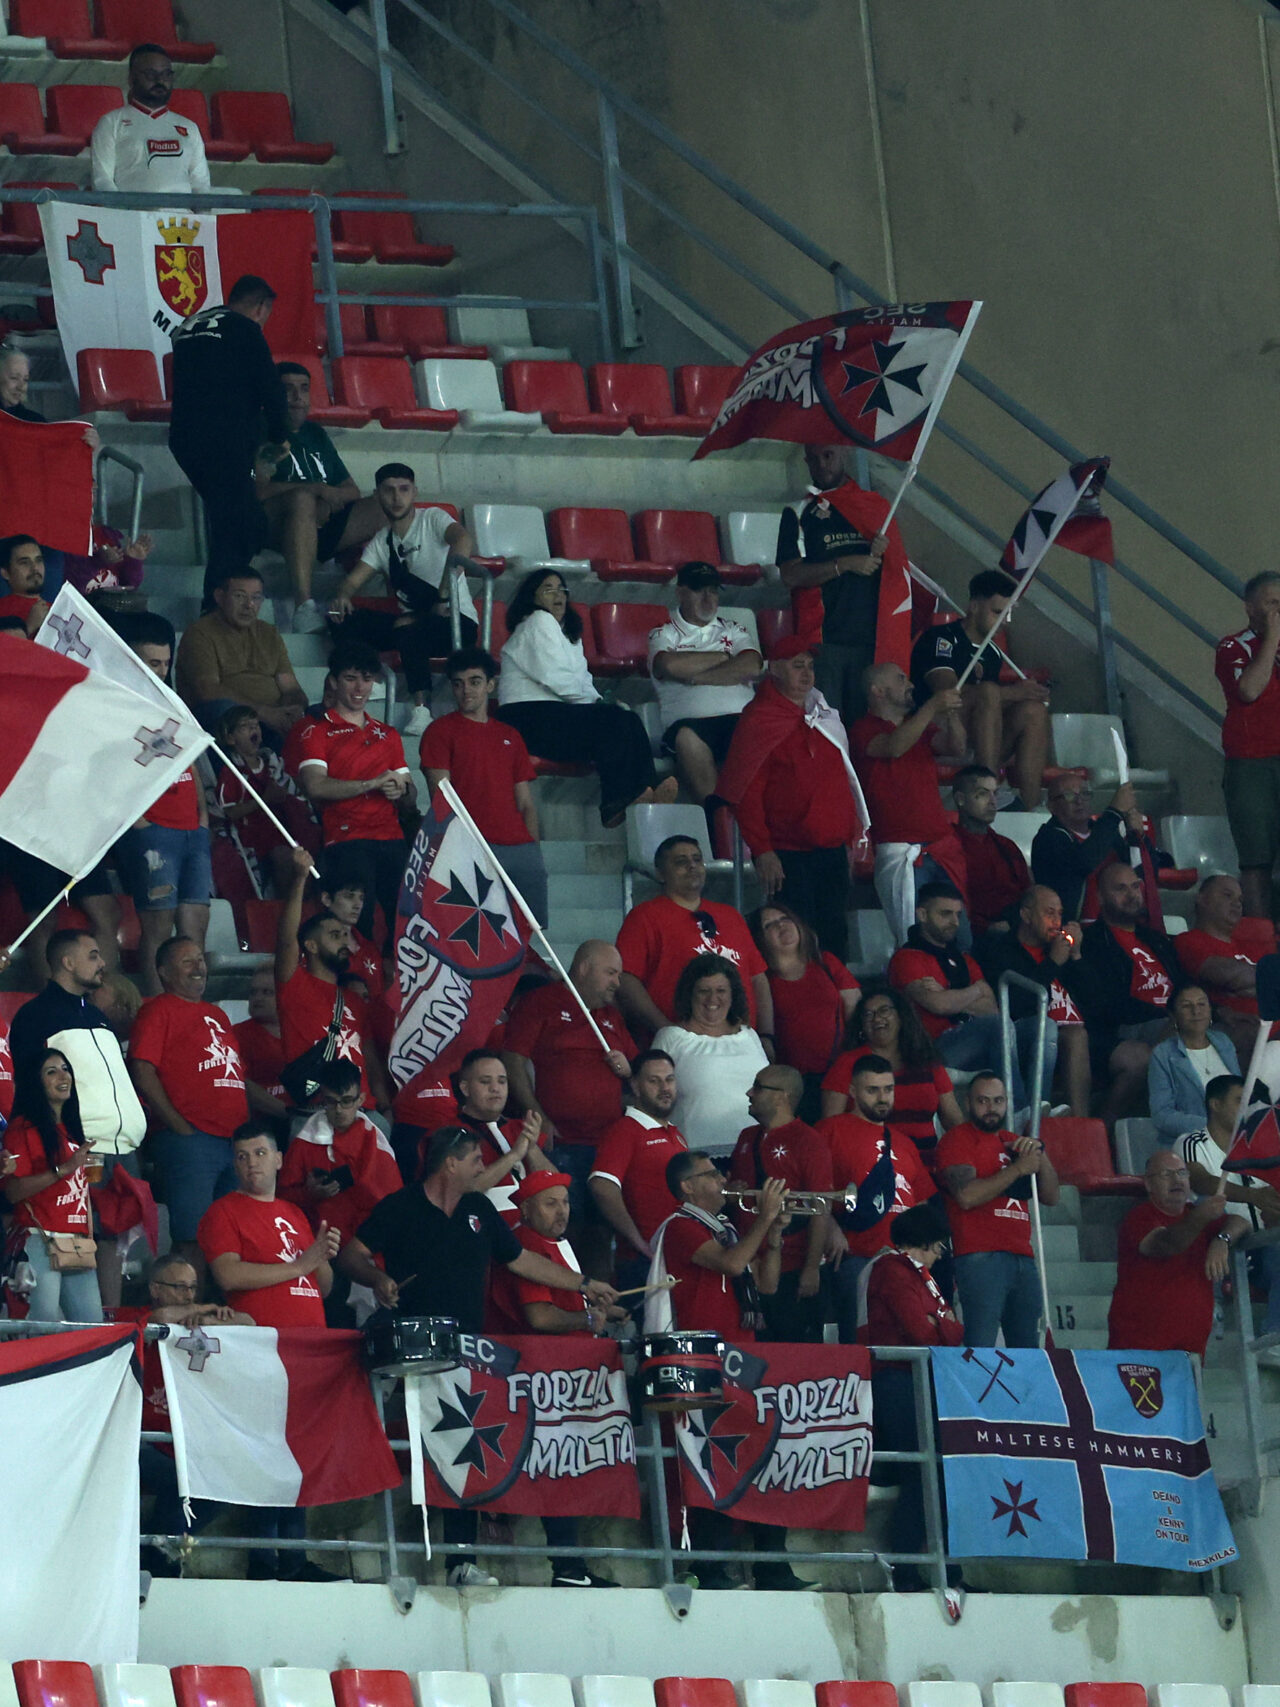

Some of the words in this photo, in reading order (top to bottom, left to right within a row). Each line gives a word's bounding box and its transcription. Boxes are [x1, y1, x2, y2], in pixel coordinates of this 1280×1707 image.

[1056, 1305, 1075, 1329] 15
[460, 1334, 496, 1363] EC
[506, 1364, 615, 1413] FORZA
[753, 1373, 862, 1425] FORZA
[521, 1421, 637, 1480] MALTA
[977, 1431, 1075, 1449] MALTESE
[1090, 1440, 1182, 1463] HAMMERS
[1155, 1529, 1168, 1539] ON
[1169, 1531, 1190, 1544] TOUR
[1158, 1517, 1185, 1530] KENNY
